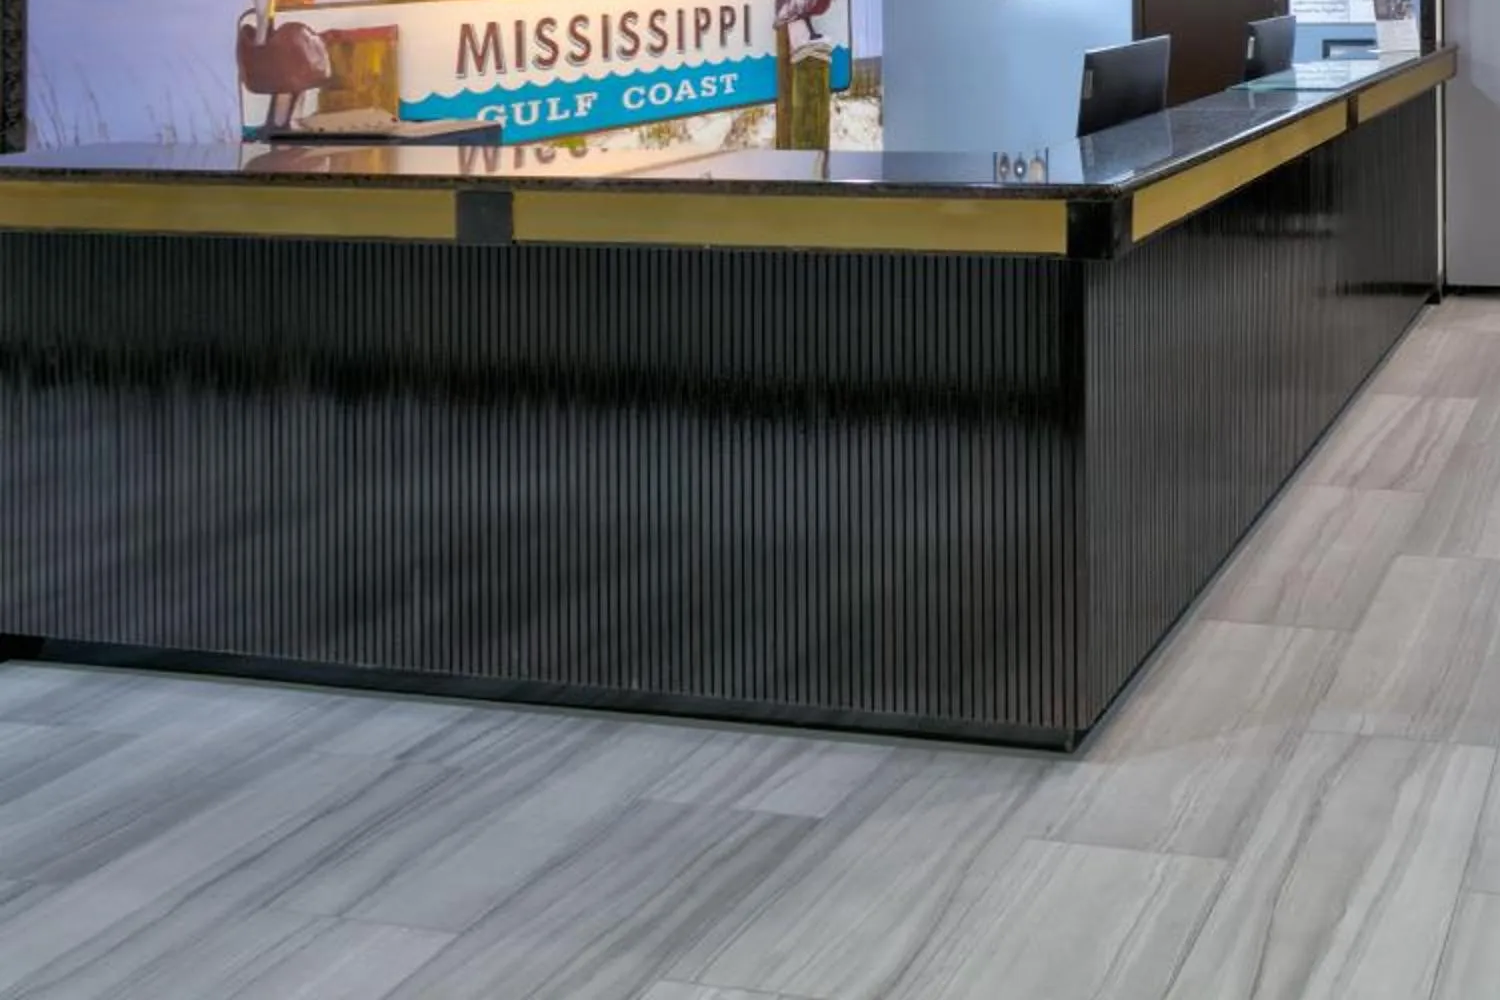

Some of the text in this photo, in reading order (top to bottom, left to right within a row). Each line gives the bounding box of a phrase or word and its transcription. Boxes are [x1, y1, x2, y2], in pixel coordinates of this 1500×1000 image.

[456, 3, 752, 79] MISSISSIPPI
[477, 73, 738, 128] GULF COAST
